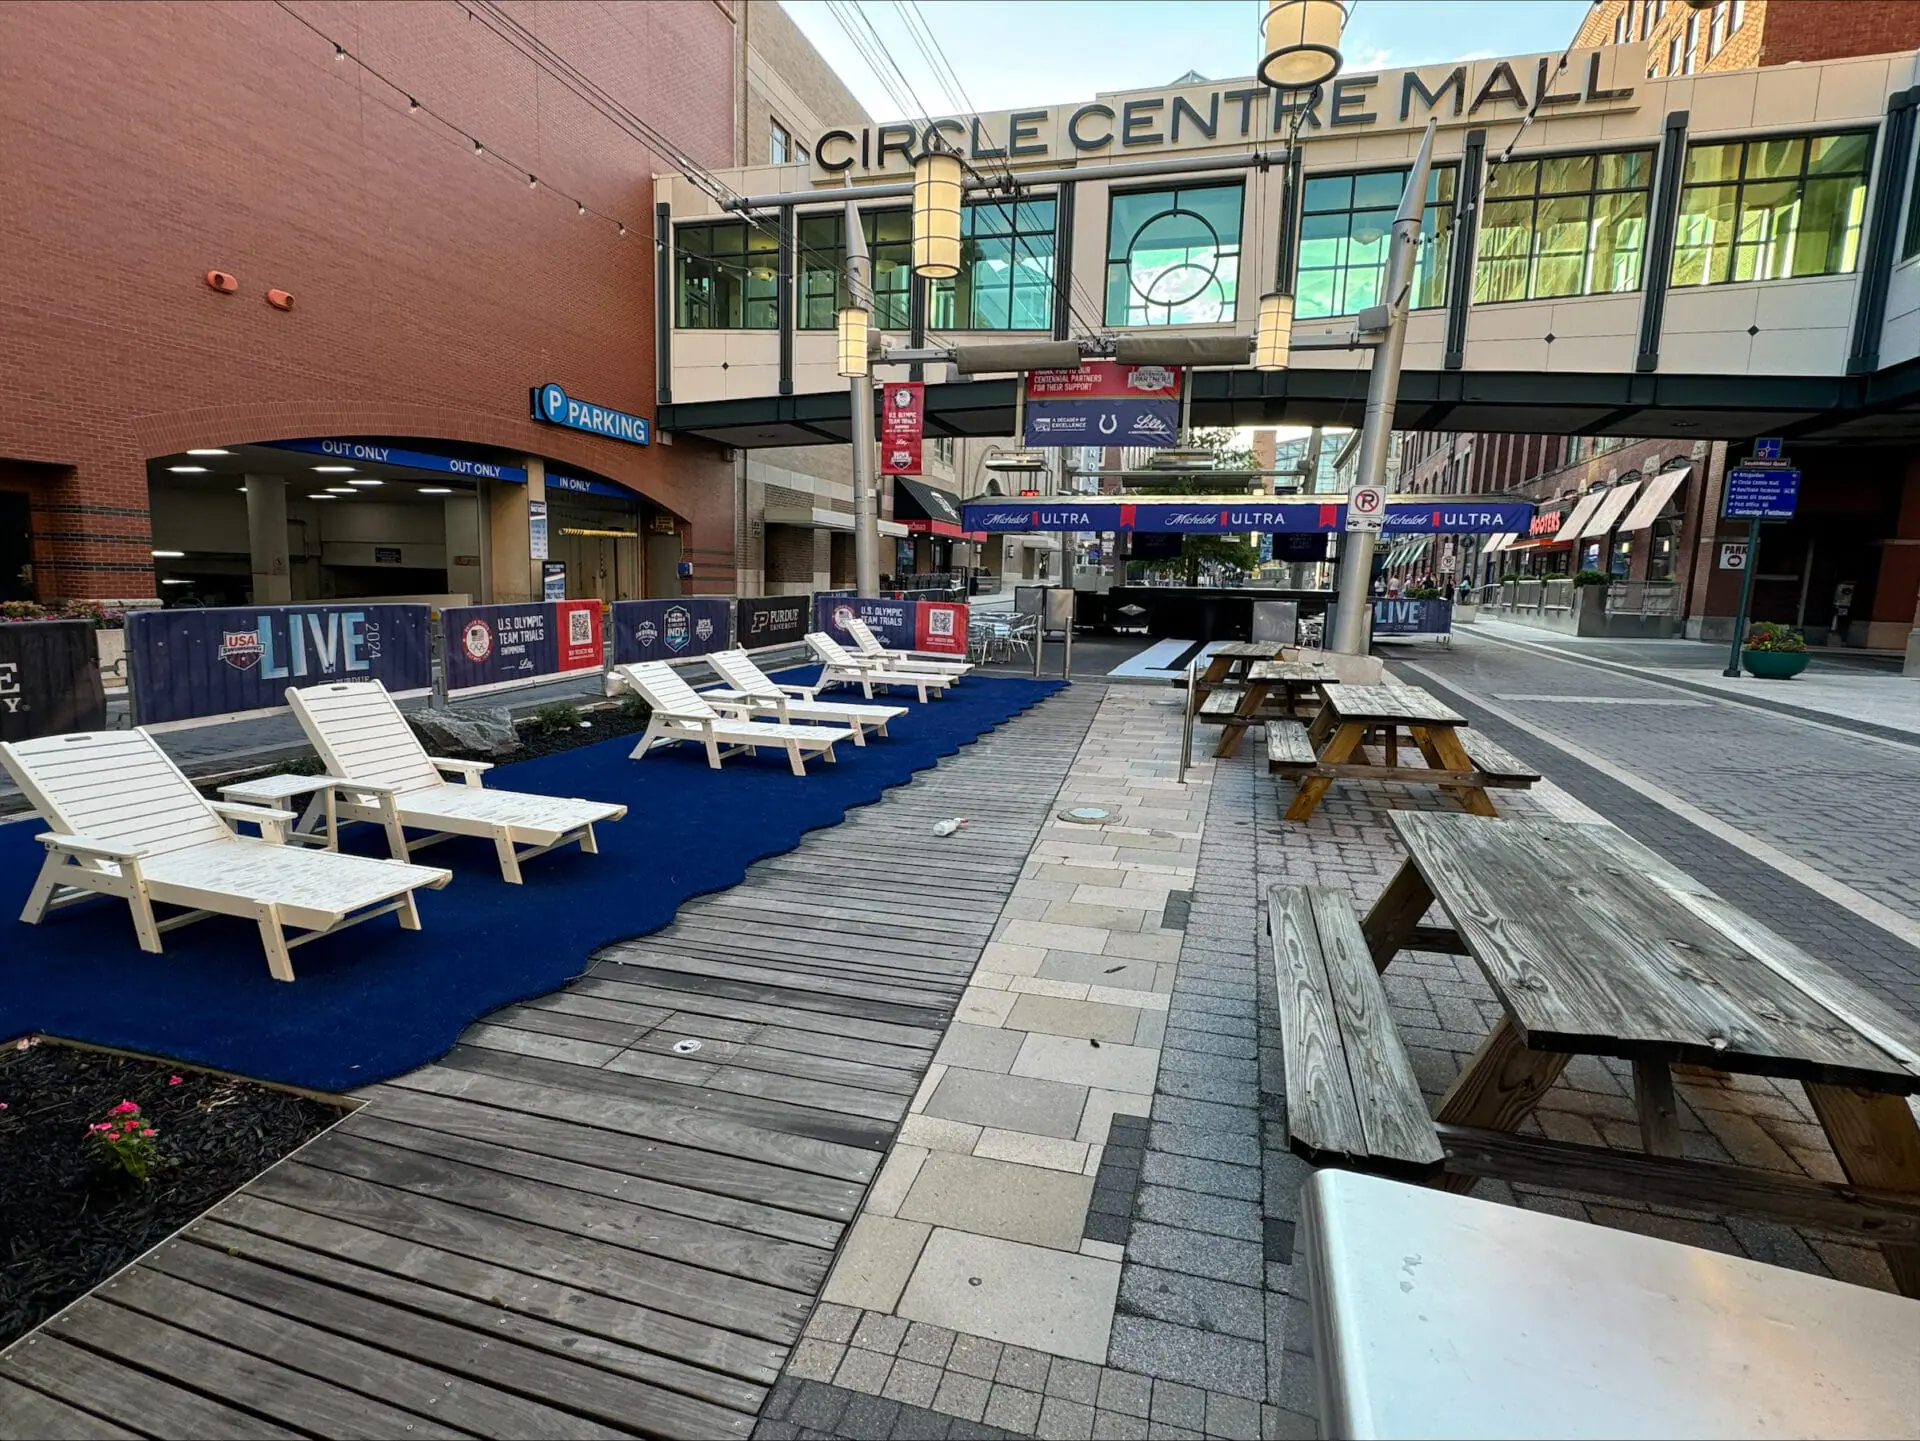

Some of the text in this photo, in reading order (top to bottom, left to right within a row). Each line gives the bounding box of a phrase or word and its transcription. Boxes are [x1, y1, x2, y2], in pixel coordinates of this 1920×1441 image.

[815, 51, 1635, 171] CIRCLE CENTRE MALL
[1071, 374, 1102, 382] PARTNERS
[1034, 383, 1092, 391] FOR THEIR SUPPORT
[568, 402, 646, 441] PARKING
[1133, 414, 1166, 431] Lilly
[322, 440, 389, 462] OUT ONLY
[450, 459, 501, 477] OUT ONLY
[559, 477, 590, 492] IN ONLY
[982, 511, 1090, 525] Michelob ULTRA
[1164, 511, 1285, 525] Michelob ULTRA
[1444, 513, 1504, 525] ULTRA
[1529, 511, 1561, 536] HOOTERS
[1724, 545, 1748, 555] PARK
[771, 609, 800, 622] PURDUE
[861, 606, 903, 617] U.S. OLYMPIC
[1375, 601, 1420, 623] LIVE
[497, 615, 544, 630] U.S. OLYMPIC
[880, 616, 903, 626] TRIALS
[499, 629, 544, 645] TEAM TRIALS
[667, 626, 686, 637] INDY
[229, 635, 256, 647] USA
[257, 612, 370, 679] LIVE
[365, 622, 382, 659] 2024
